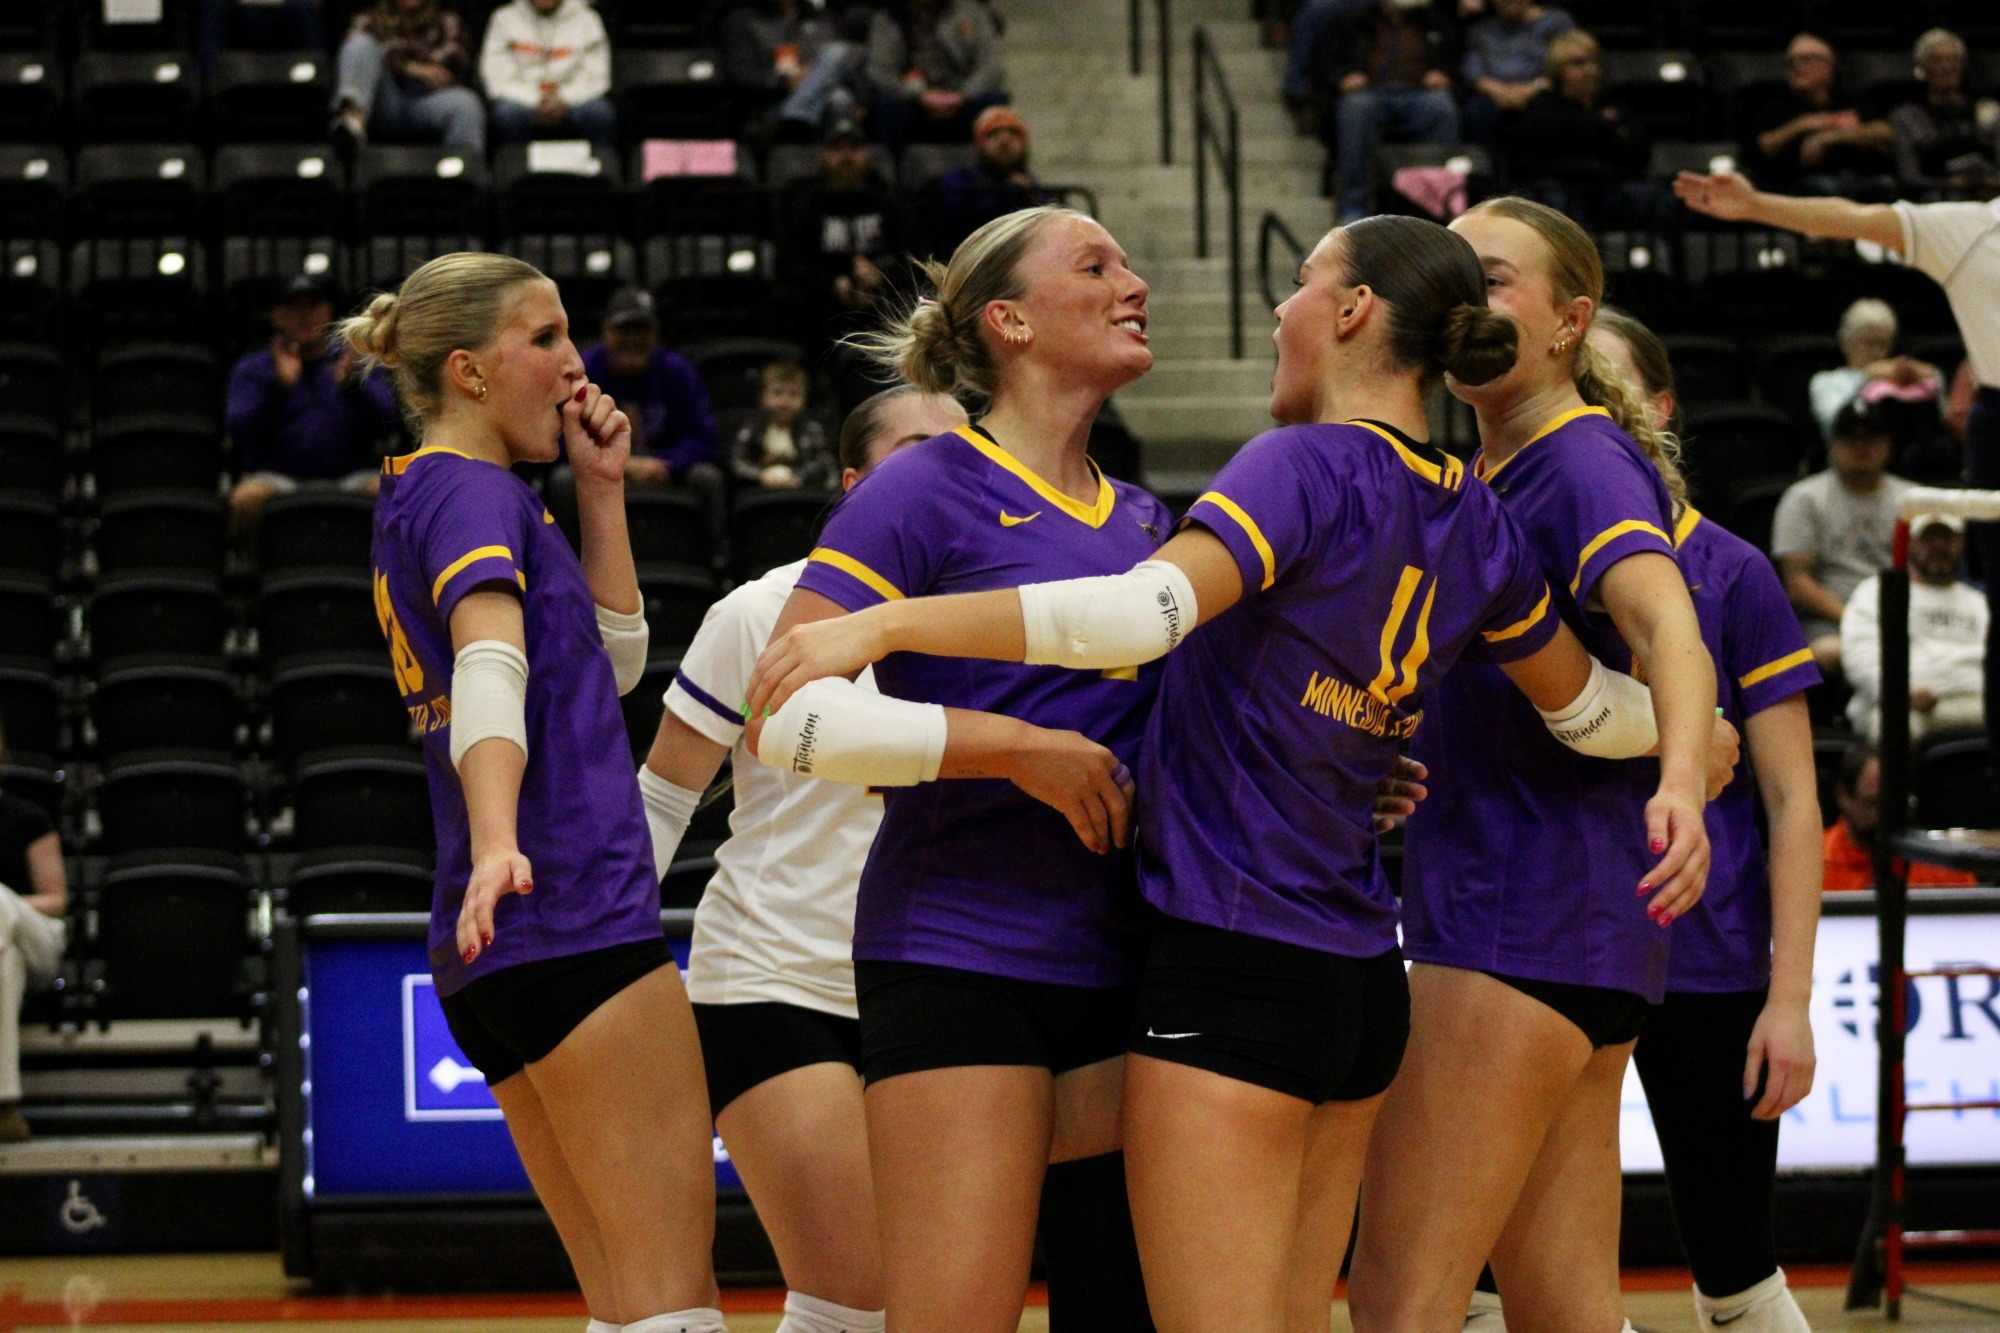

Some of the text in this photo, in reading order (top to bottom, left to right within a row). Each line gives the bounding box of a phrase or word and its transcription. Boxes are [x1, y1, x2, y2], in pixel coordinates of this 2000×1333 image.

[1367, 564, 1438, 707] 11
[793, 712, 819, 773] Tandem
[1553, 706, 1611, 743] Tandem
